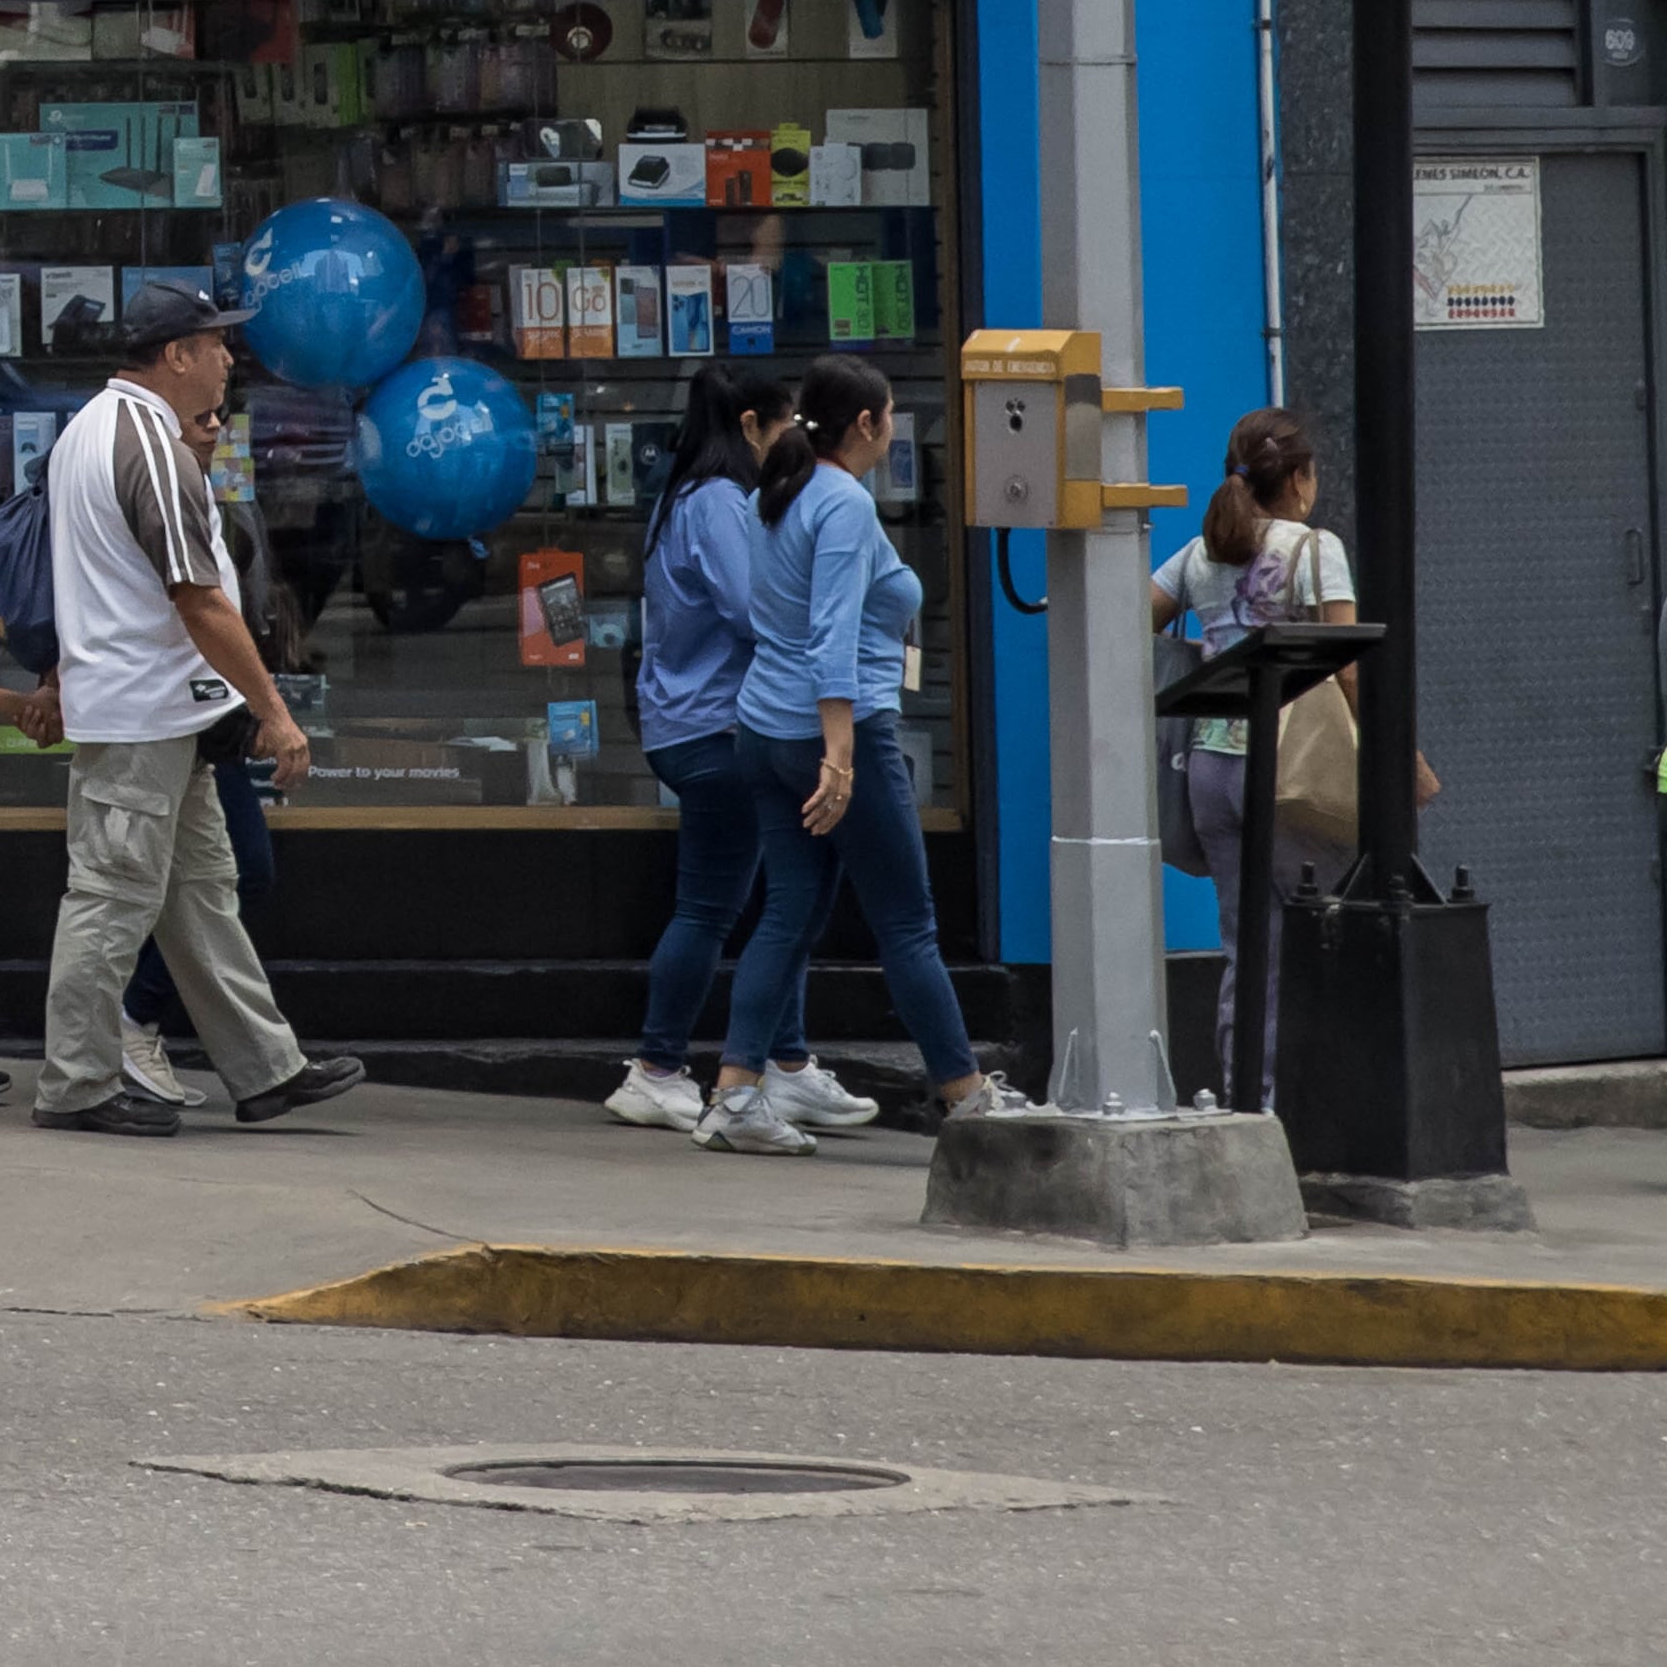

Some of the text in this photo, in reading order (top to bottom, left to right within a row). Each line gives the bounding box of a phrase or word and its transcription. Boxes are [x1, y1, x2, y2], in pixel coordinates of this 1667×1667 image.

[525, 283, 560, 321] 10
[731, 276, 769, 318] 20
[993, 359, 1004, 373] DE
[308, 765, 460, 781] Power to your movies
